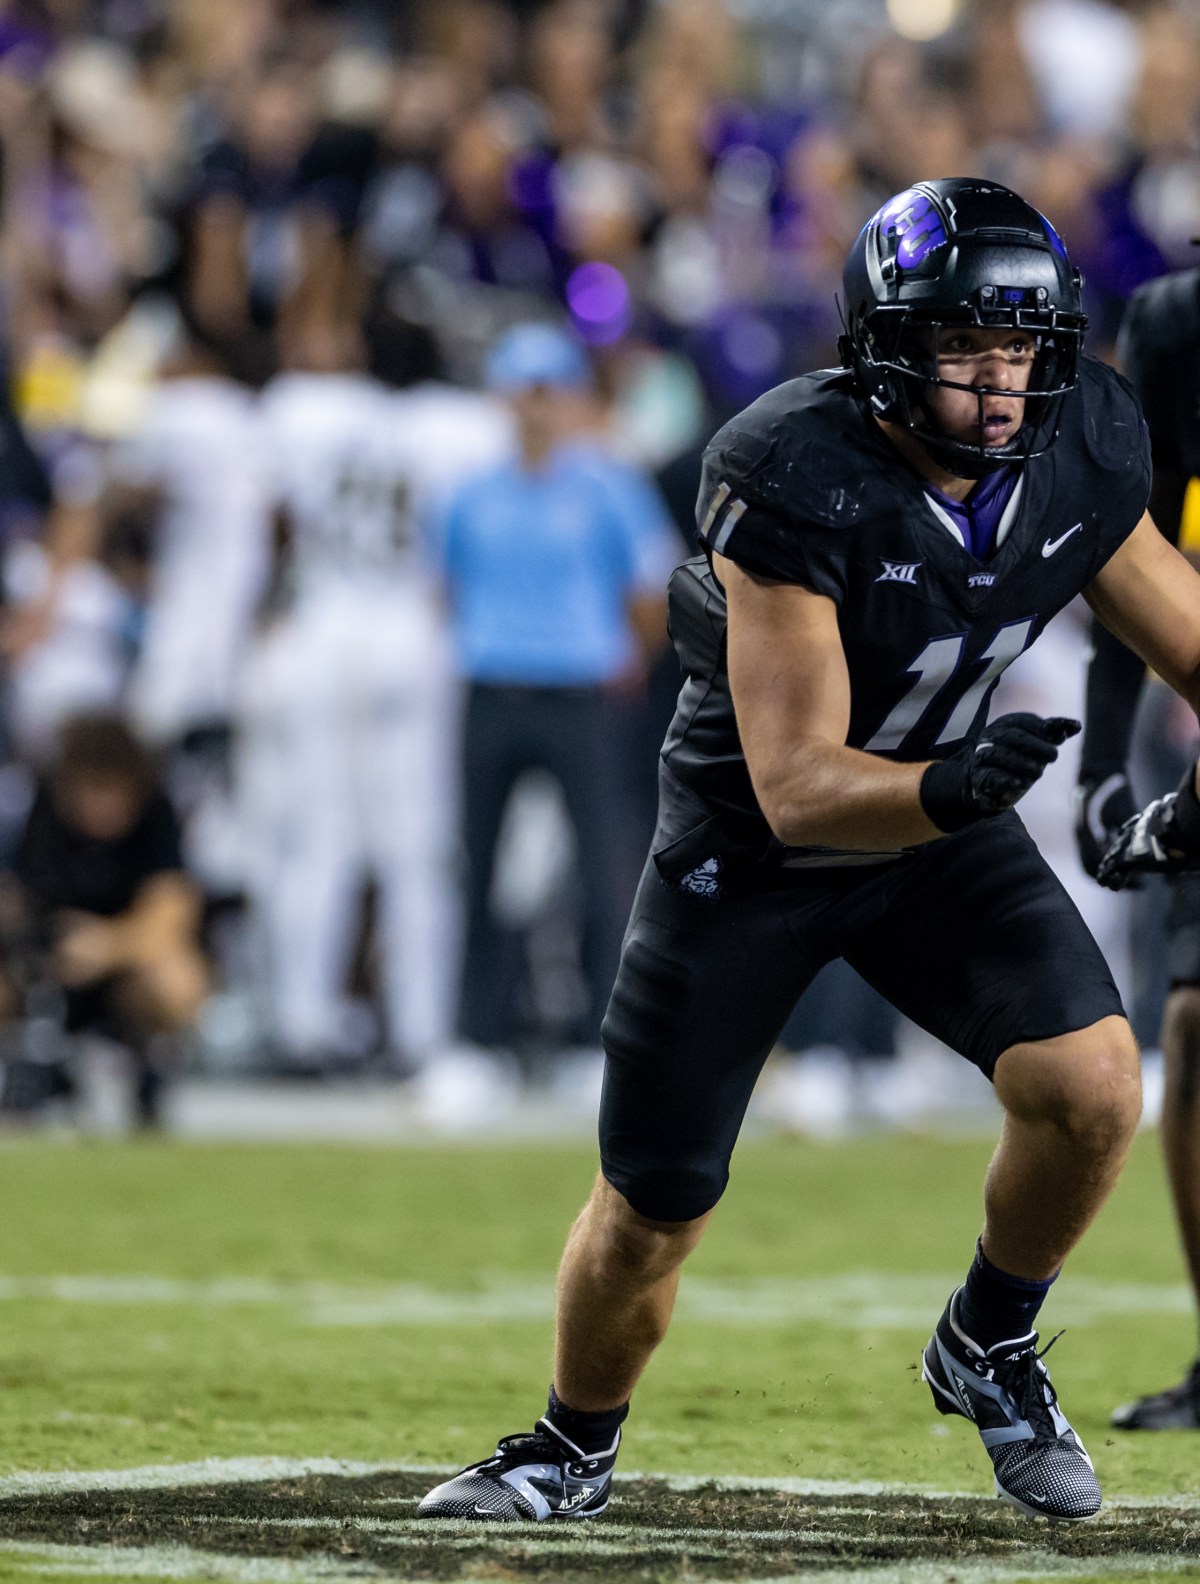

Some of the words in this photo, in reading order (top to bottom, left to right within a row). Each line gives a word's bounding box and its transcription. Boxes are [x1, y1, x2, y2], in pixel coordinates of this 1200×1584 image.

[701, 481, 748, 555] 11
[874, 561, 923, 585] XII
[967, 573, 997, 588] TCU
[860, 614, 1037, 750] 11
[558, 1486, 595, 1510] ALPHA
